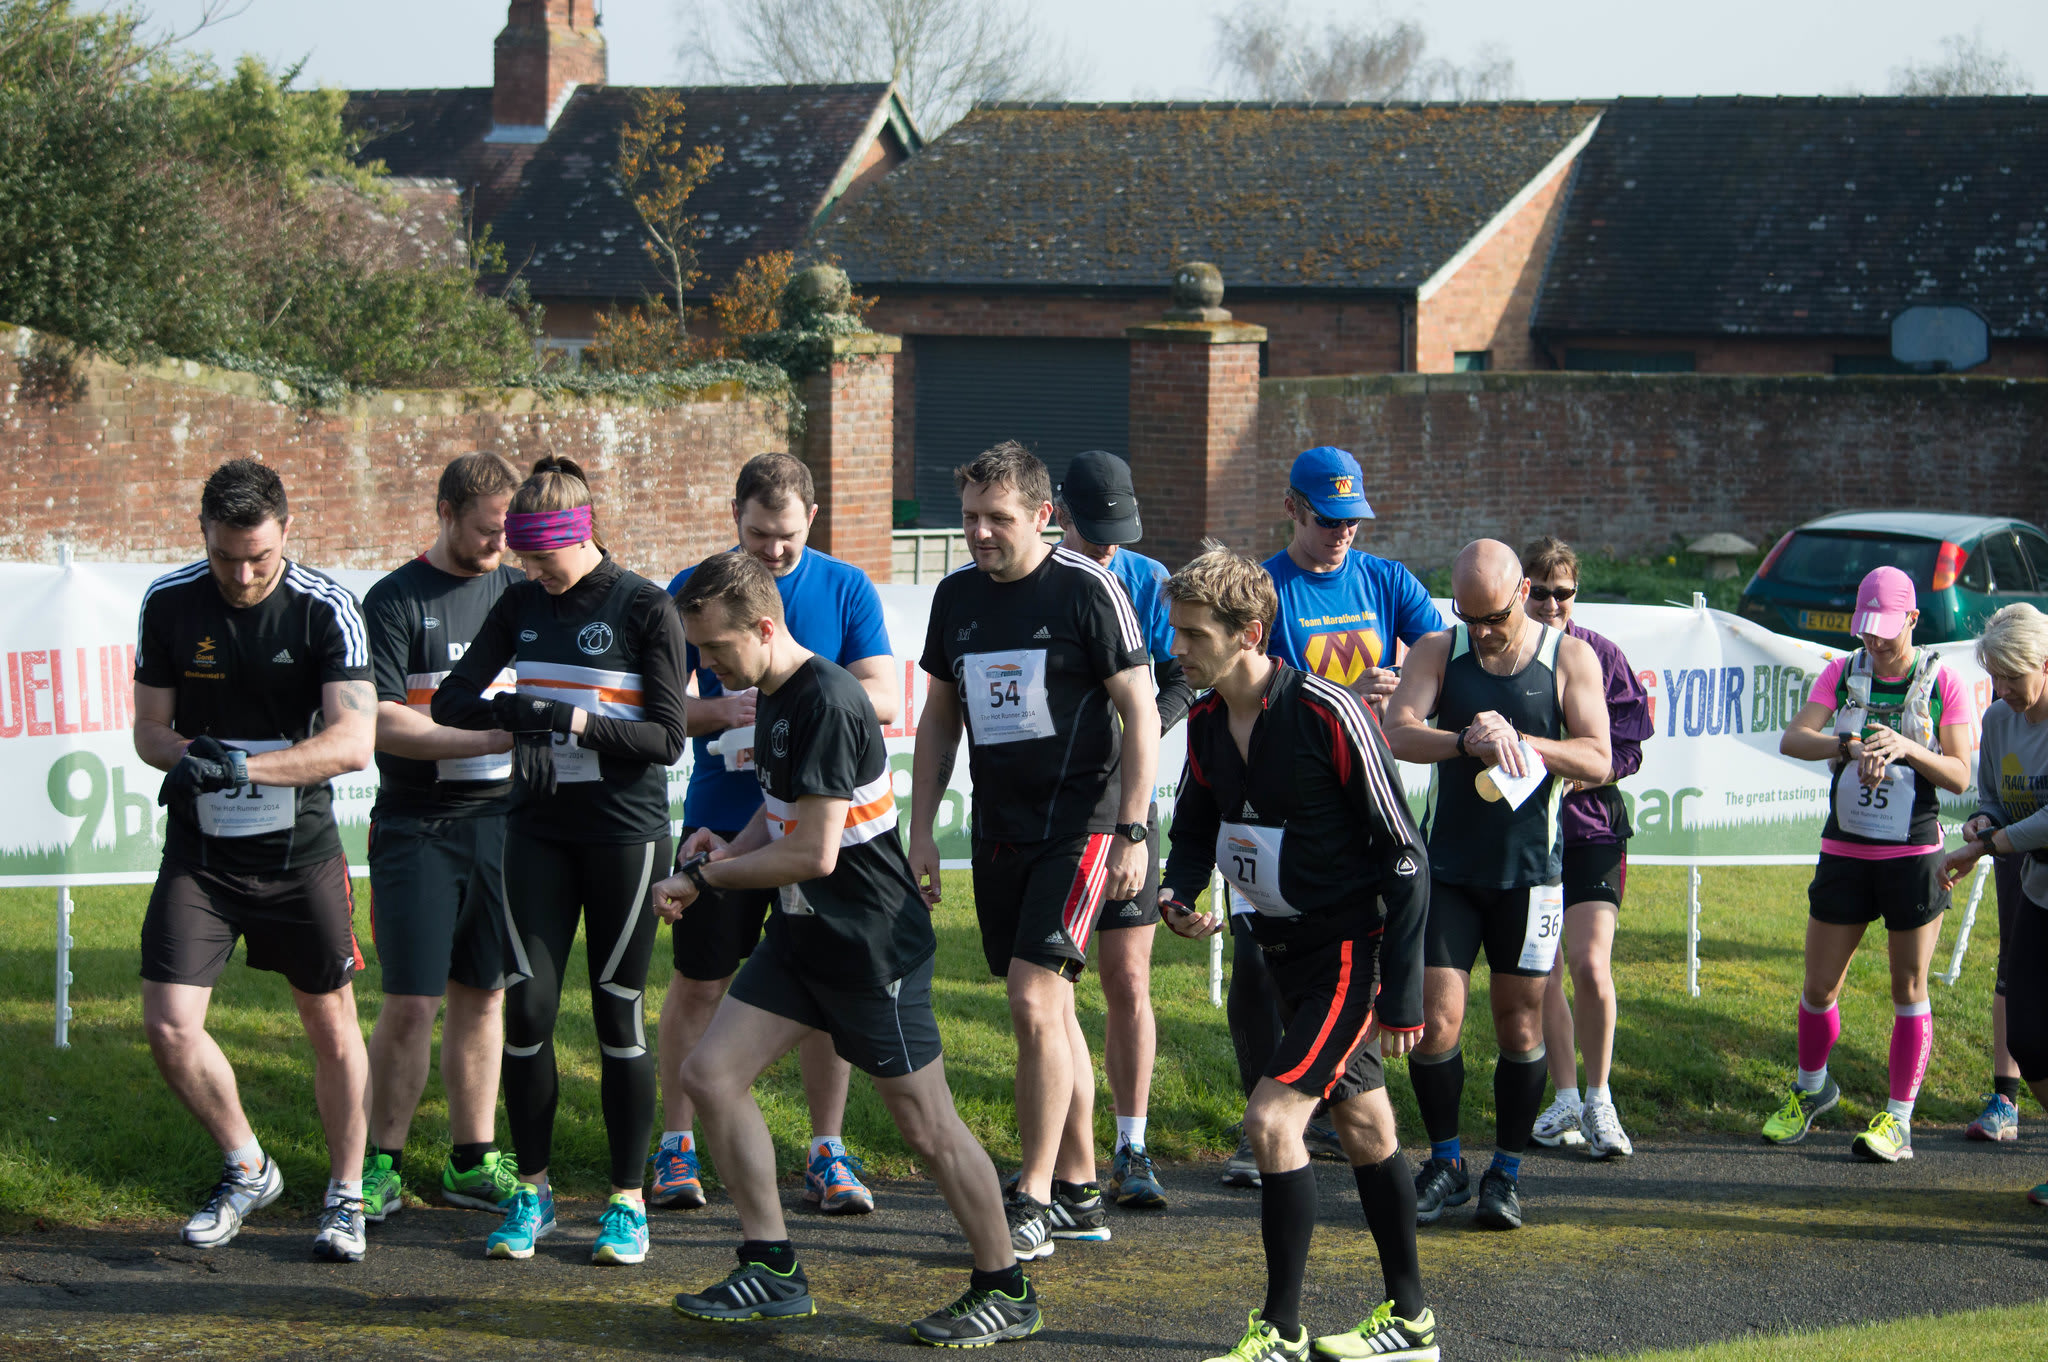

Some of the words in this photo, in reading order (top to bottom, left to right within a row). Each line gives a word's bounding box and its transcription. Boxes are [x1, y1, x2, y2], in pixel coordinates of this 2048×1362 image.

[1299, 617, 1322, 628] Team
[1322, 613, 1361, 625] Marathon
[1361, 610, 1377, 621] Man
[989, 680, 1021, 708] 54
[1663, 667, 1745, 737] YOUR
[1021, 710, 1036, 718] 2014
[263, 803, 280, 811] 2014
[1725, 791, 1744, 806] The
[1746, 790, 1775, 808] great
[1778, 786, 1815, 806] tasting
[1858, 785, 1889, 809] 35
[1880, 813, 1893, 821] 2014
[1233, 855, 1256, 884] 27
[1119, 909, 1143, 917] adidas
[1538, 913, 1560, 938] 36
